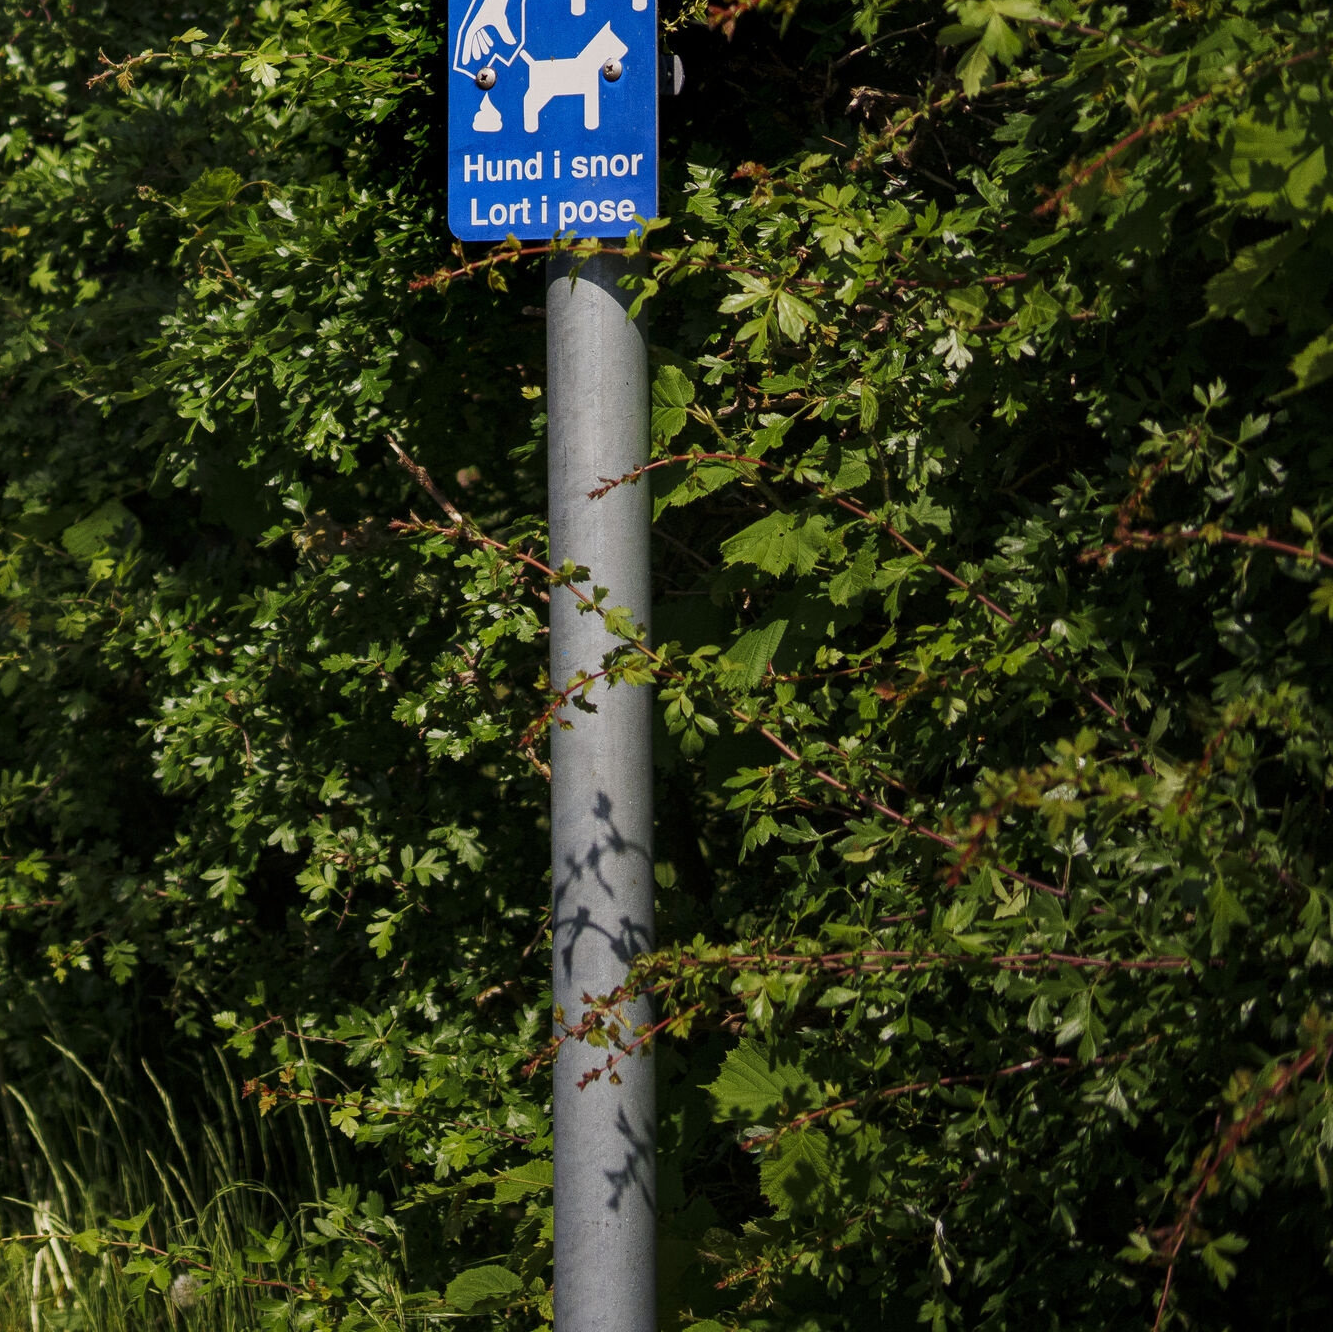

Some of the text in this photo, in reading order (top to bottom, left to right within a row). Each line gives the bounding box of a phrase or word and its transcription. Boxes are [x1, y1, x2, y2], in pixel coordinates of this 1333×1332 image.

[464, 151, 644, 182] Hund i snor
[470, 196, 637, 231] Lort i pose
